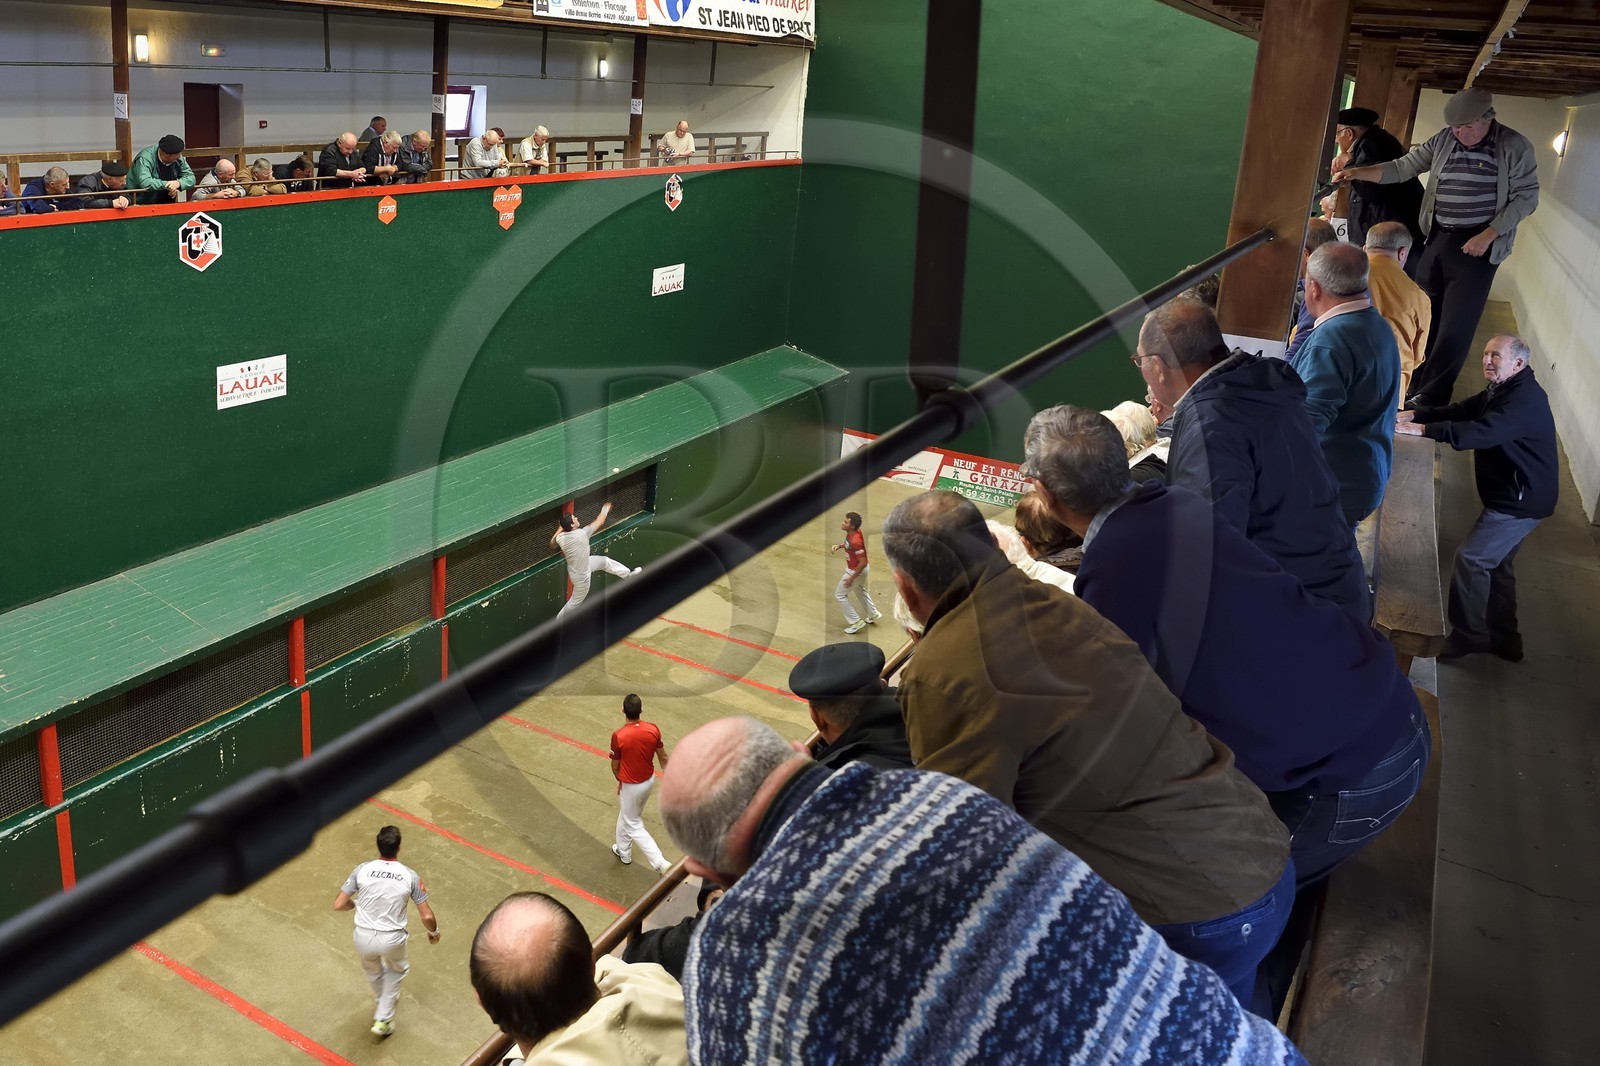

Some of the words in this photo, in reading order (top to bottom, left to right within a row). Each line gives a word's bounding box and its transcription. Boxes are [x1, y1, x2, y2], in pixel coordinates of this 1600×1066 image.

[698, 6, 712, 25] ST
[717, 9, 745, 29] JEAN
[746, 14, 770, 32] PIED
[772, 18, 787, 34] DE
[653, 280, 682, 295] LAUAK
[219, 372, 285, 396] LAUAK
[953, 458, 977, 470] NEUF
[982, 465, 995, 474] ET
[952, 486, 964, 495] 05
[966, 489, 977, 497] 59
[994, 495, 1005, 503] 03
